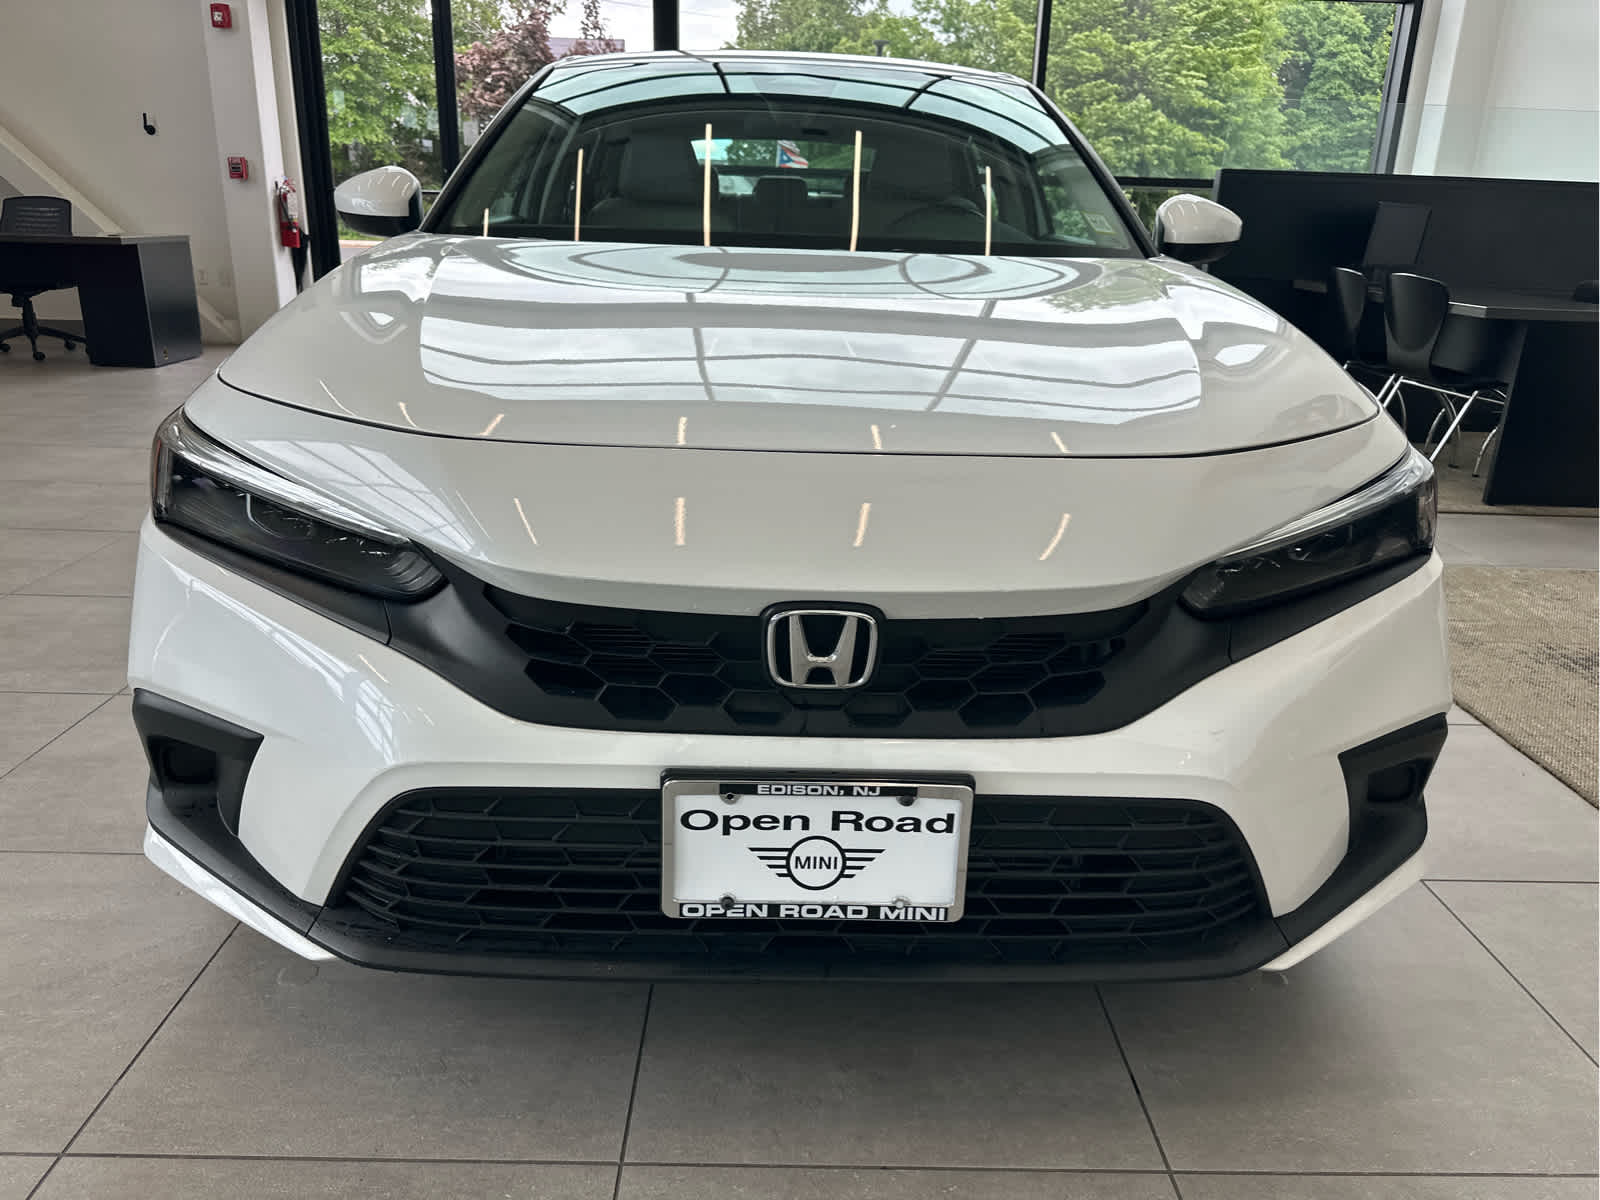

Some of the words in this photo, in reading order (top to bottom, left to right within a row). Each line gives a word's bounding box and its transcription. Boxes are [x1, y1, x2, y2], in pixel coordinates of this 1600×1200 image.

[757, 784, 845, 796] EDISON,
[852, 786, 880, 796] NJ
[680, 809, 810, 836] Open
[831, 810, 955, 834] Road
[794, 855, 838, 870] MINI
[682, 903, 768, 918] OPEN
[779, 904, 869, 919] ROAD
[879, 906, 945, 921] MINI
